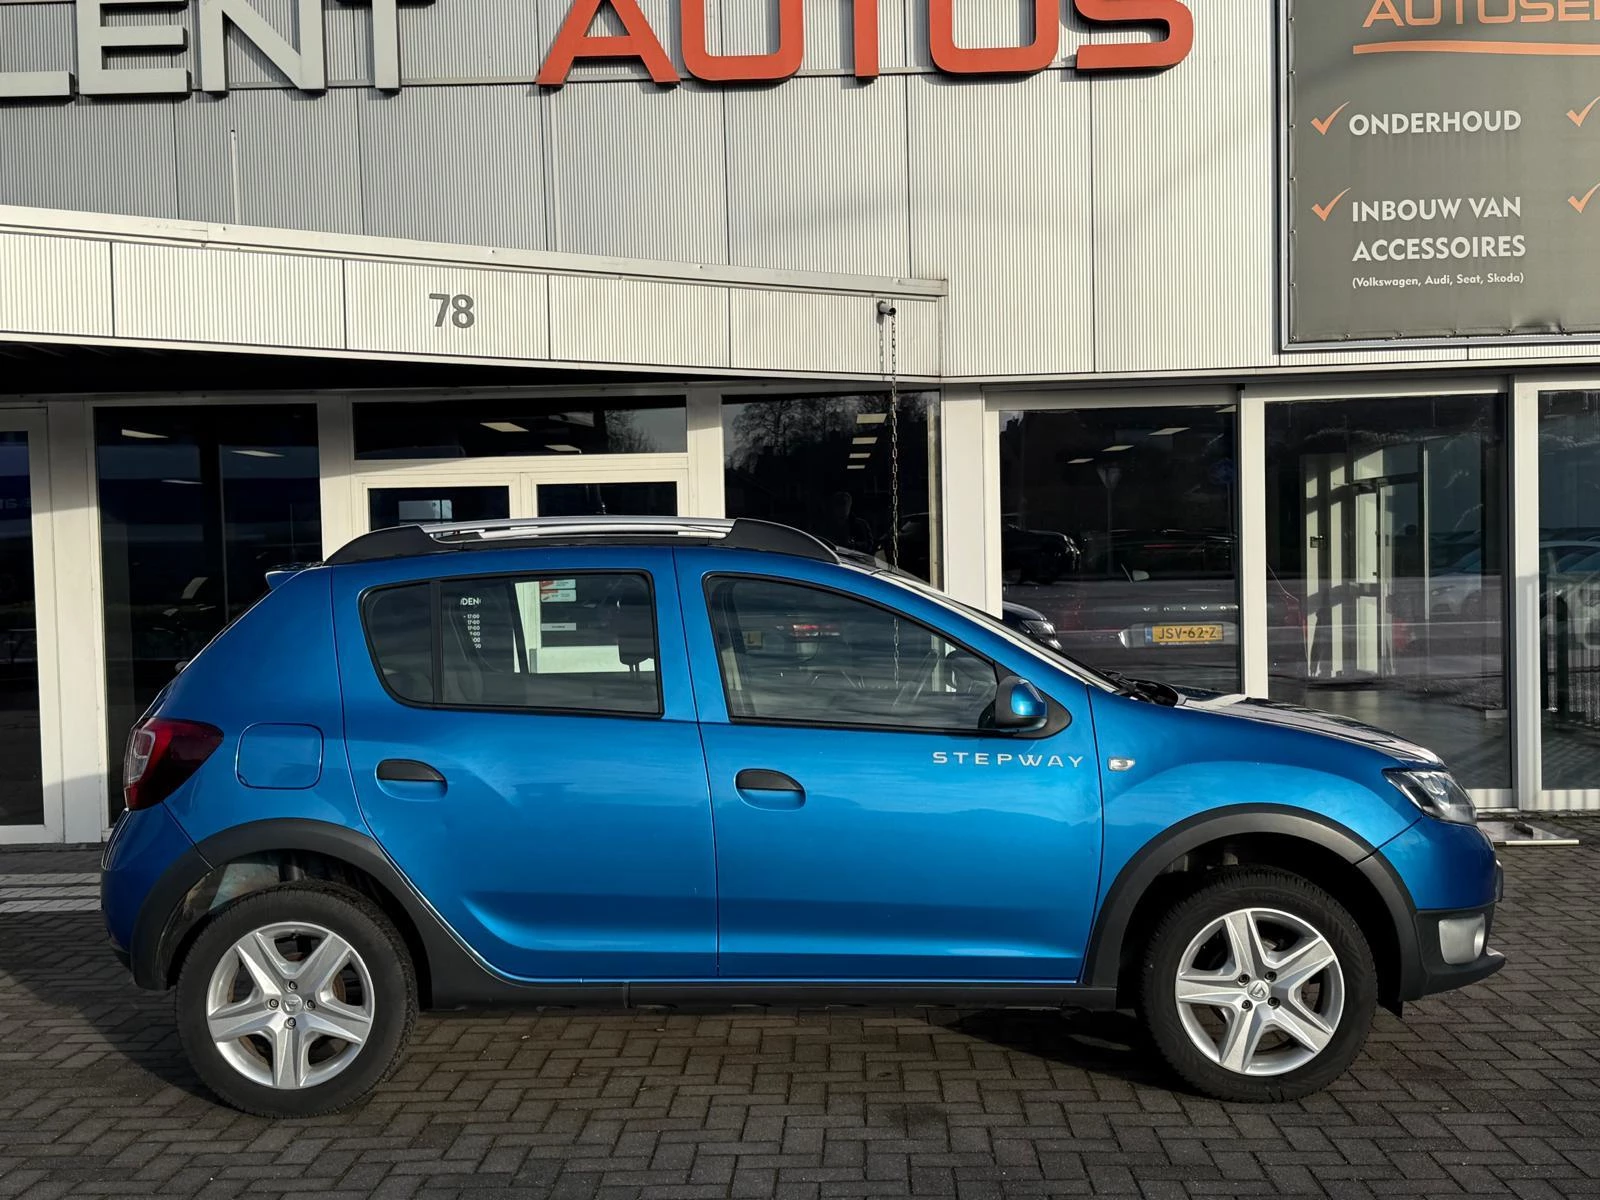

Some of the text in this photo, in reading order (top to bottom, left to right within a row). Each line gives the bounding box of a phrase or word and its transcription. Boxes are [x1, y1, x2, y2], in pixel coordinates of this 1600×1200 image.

[1362, 0, 1600, 28] AUTOSE
[535, 0, 1193, 86] AUTOS
[1349, 110, 1522, 136] ONDERHOUD
[1352, 196, 1521, 222] INBOUW VAN
[1352, 235, 1526, 262] ACCESSOIRES
[1352, 272, 1524, 289] (Volkswagen, Audi, Seat, Skoda)
[429, 293, 475, 329] 78
[1158, 627, 1217, 640] JSV-62-Z
[932, 751, 1083, 768] STEPWAY
